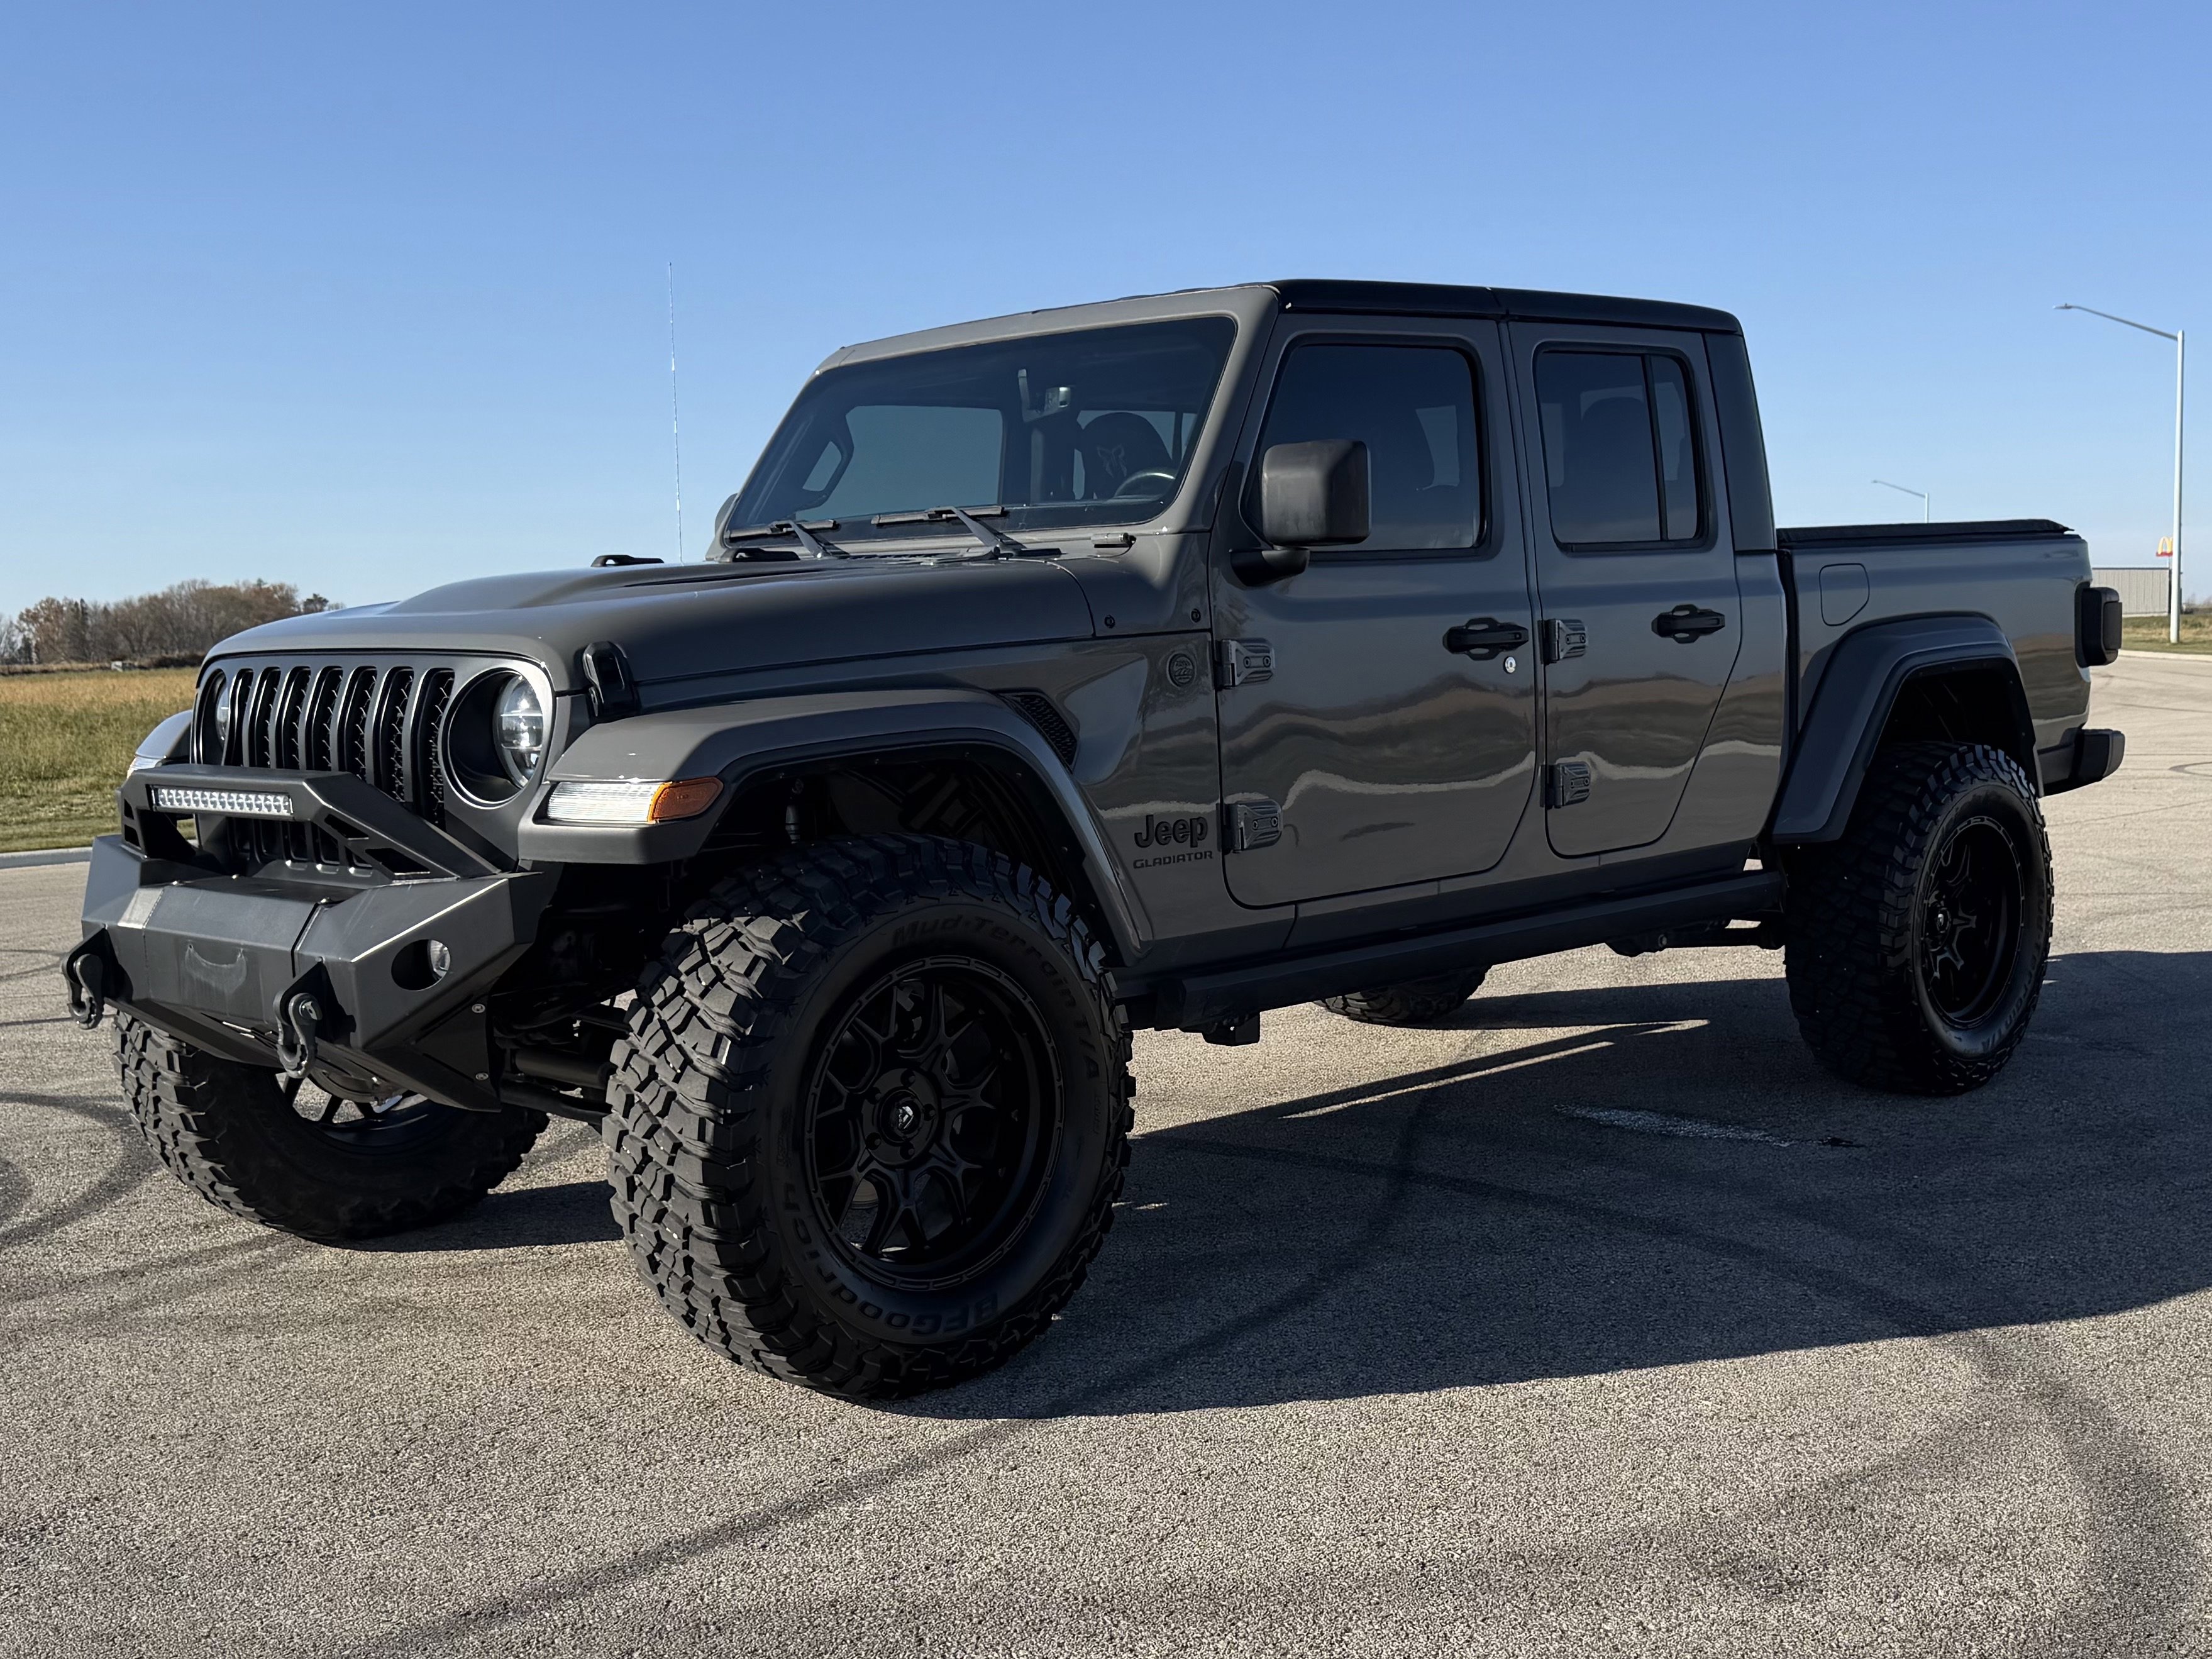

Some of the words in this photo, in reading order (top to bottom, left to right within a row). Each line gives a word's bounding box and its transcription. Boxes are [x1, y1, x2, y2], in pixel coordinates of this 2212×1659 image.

[1134, 815, 1208, 848] Jeep
[1133, 850, 1213, 869] GLADIATOR
[783, 1183, 998, 1336] BFGoodrich
